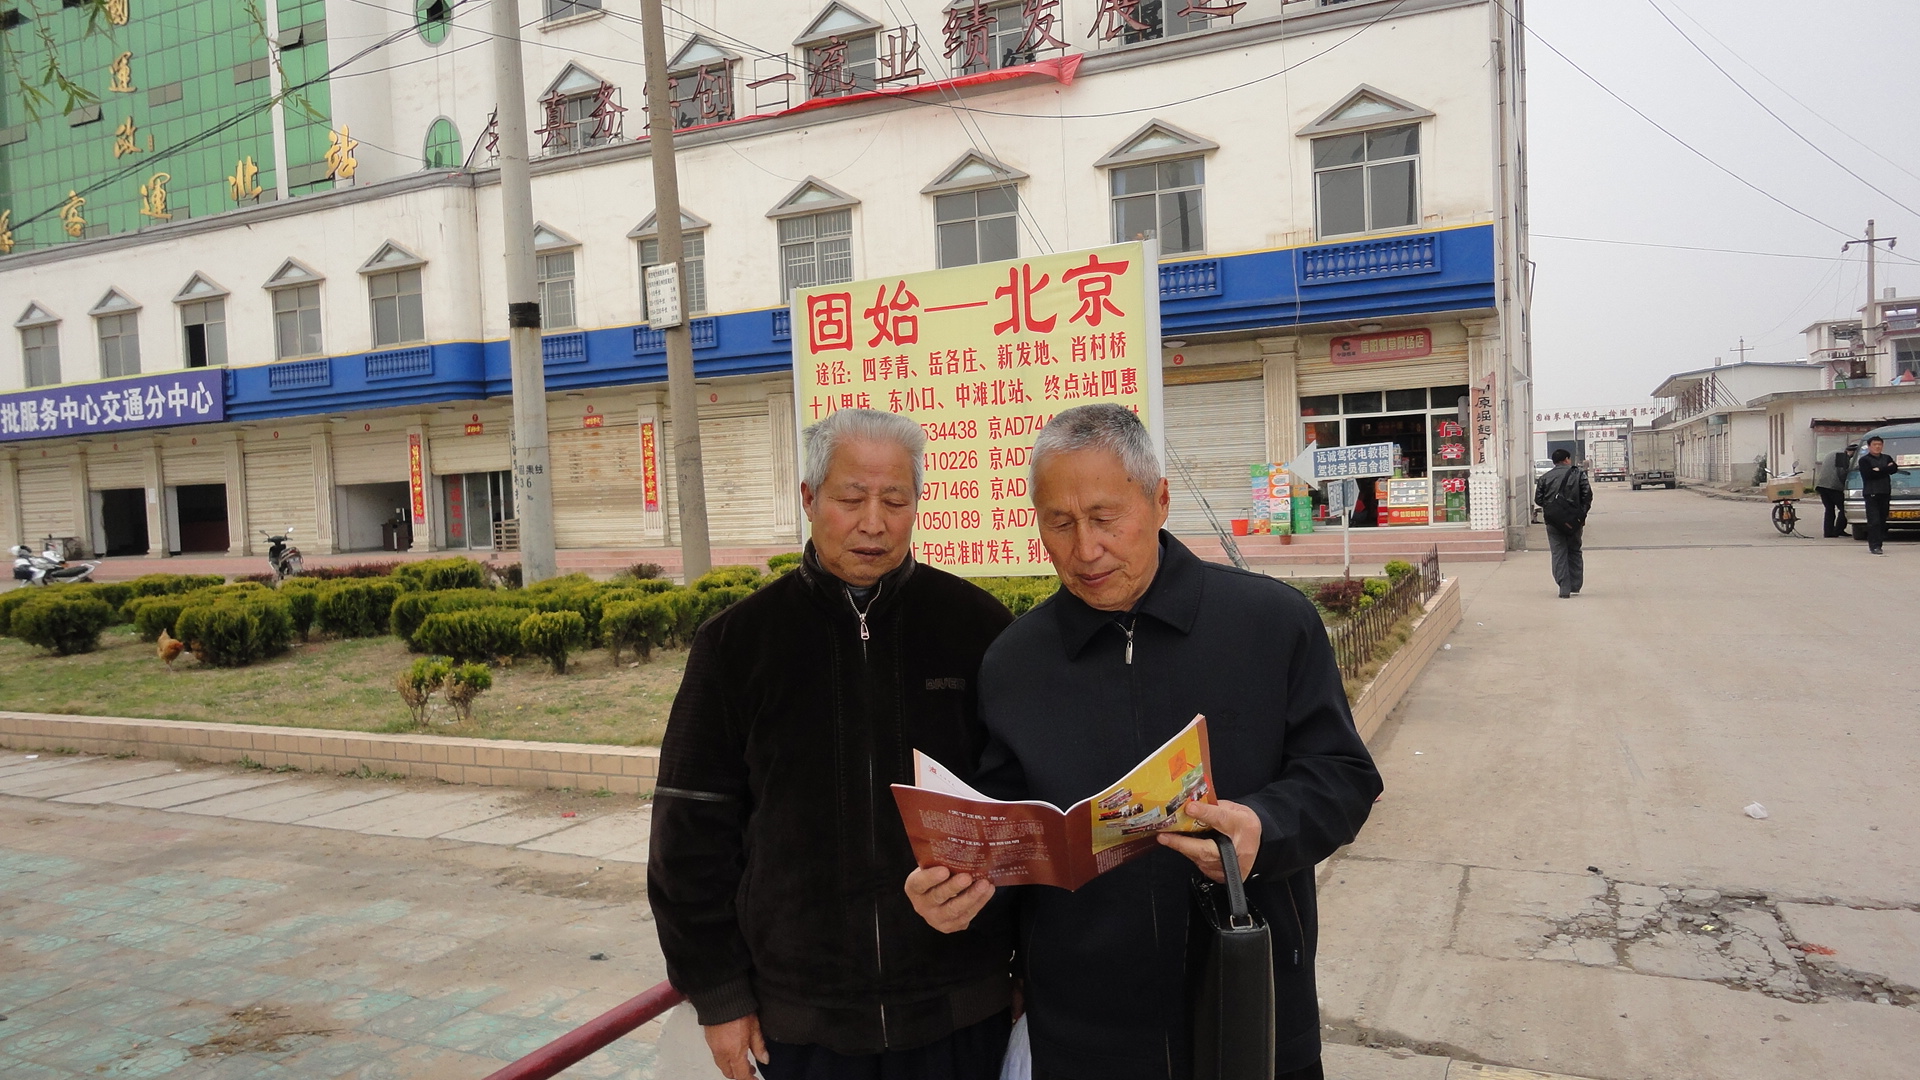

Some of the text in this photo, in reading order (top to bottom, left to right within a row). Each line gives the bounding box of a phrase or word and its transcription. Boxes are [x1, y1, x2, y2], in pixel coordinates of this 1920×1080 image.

[0, 381, 214, 434] 批服务中心交通分中心
[1317, 445, 1389, 463] 远诚驾校电教楼
[1318, 460, 1389, 476] 驾校学员宿舍楼
[919, 477, 1028, 501] 971466 京AD
